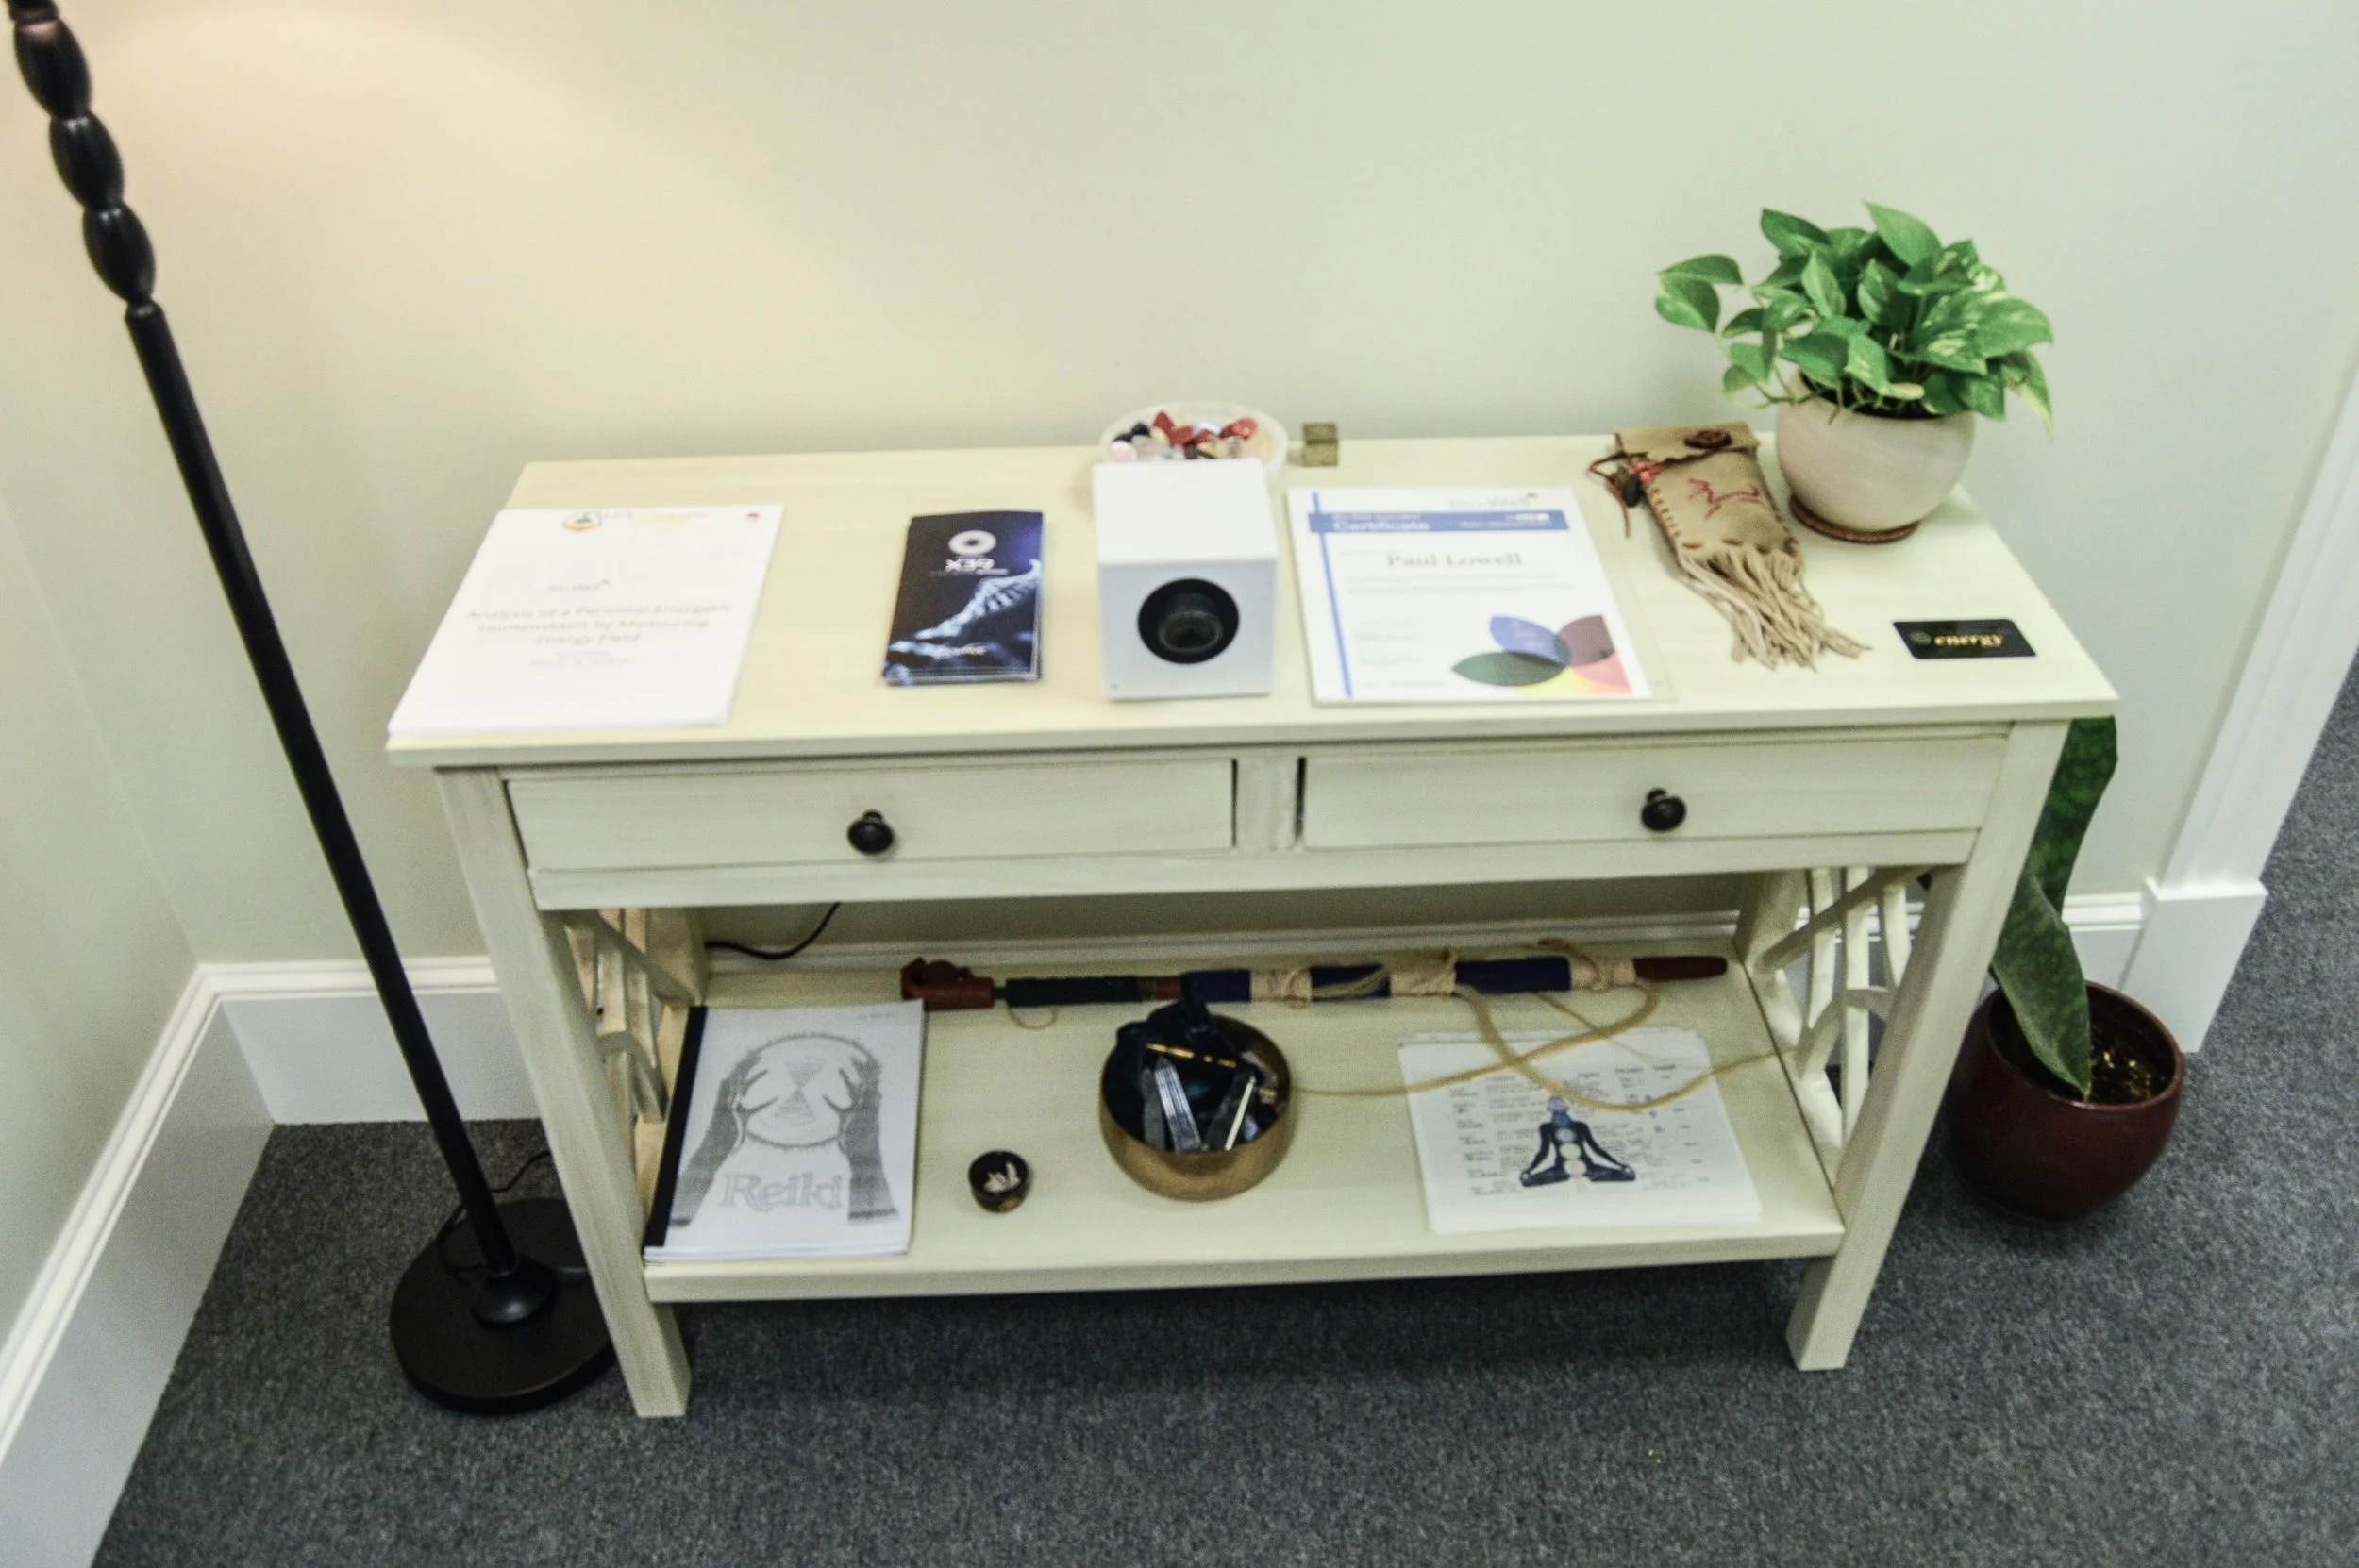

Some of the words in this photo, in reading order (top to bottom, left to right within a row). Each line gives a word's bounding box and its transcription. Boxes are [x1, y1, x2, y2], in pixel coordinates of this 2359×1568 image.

[1386, 553, 1438, 568] Paul
[1445, 551, 1523, 567] Lowell
[718, 1171, 844, 1213] Reiki
